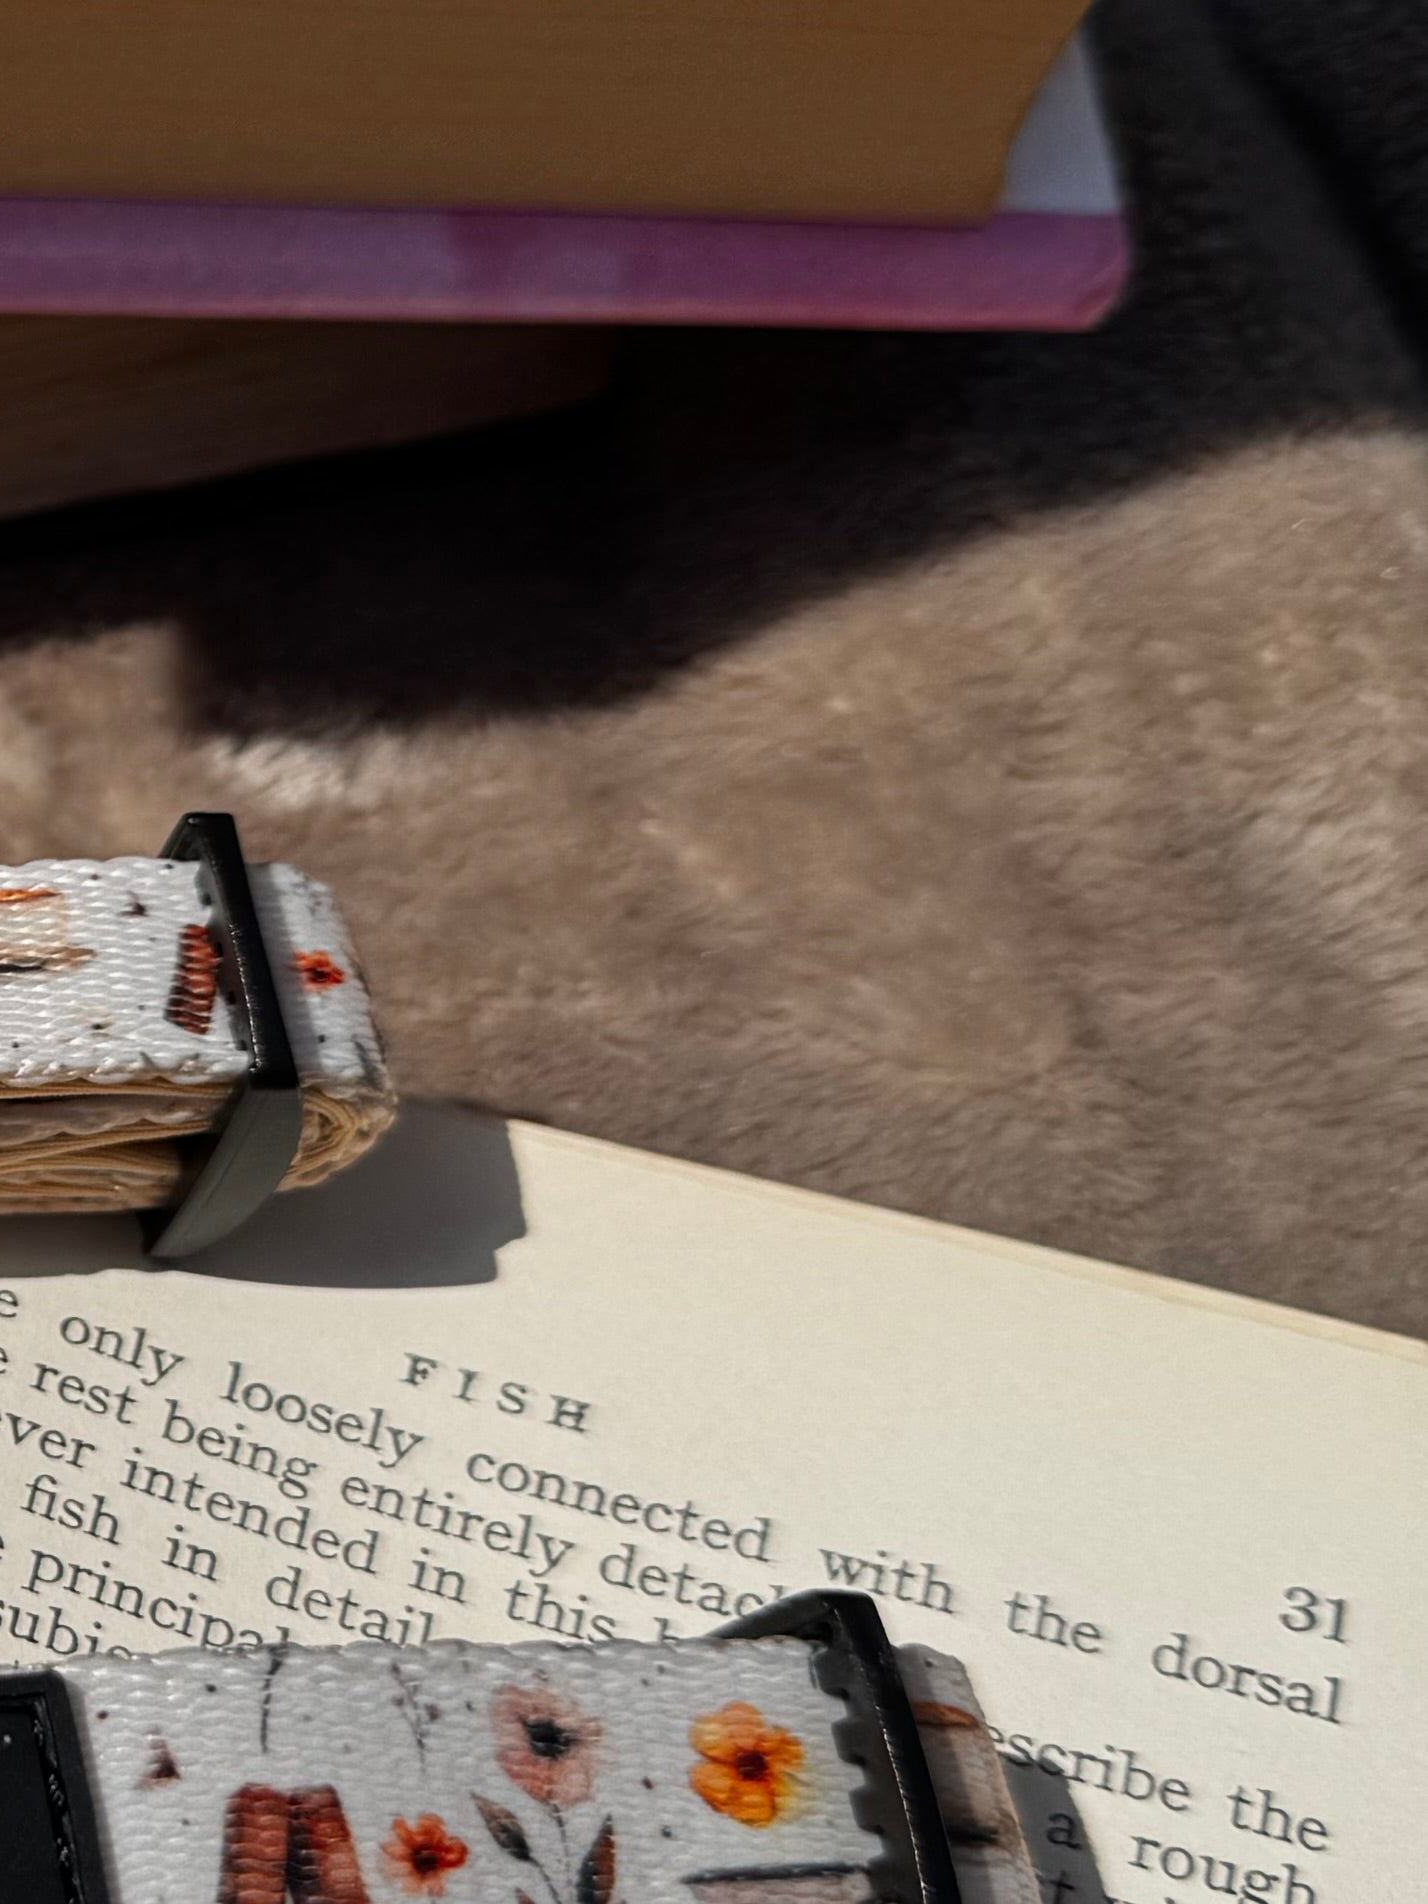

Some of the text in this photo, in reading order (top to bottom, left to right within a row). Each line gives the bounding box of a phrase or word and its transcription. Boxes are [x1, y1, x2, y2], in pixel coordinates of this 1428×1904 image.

[402, 1354, 590, 1433] FISH
[20, 1475, 120, 1546] fish
[162, 1525, 217, 1583] in
[30, 1363, 137, 1424] rest
[162, 1399, 319, 1499] being
[341, 1477, 575, 1577] entirely
[60, 1317, 185, 1387] only
[220, 1361, 424, 1469] loosely
[467, 1454, 771, 1563] connected
[820, 1549, 955, 1614] with
[1005, 1593, 1103, 1653] the
[1153, 1633, 1341, 1724] dorsal
[120, 1459, 379, 1575] intended
[408, 1548, 466, 1604] in
[1280, 1587, 1346, 1643] 31
